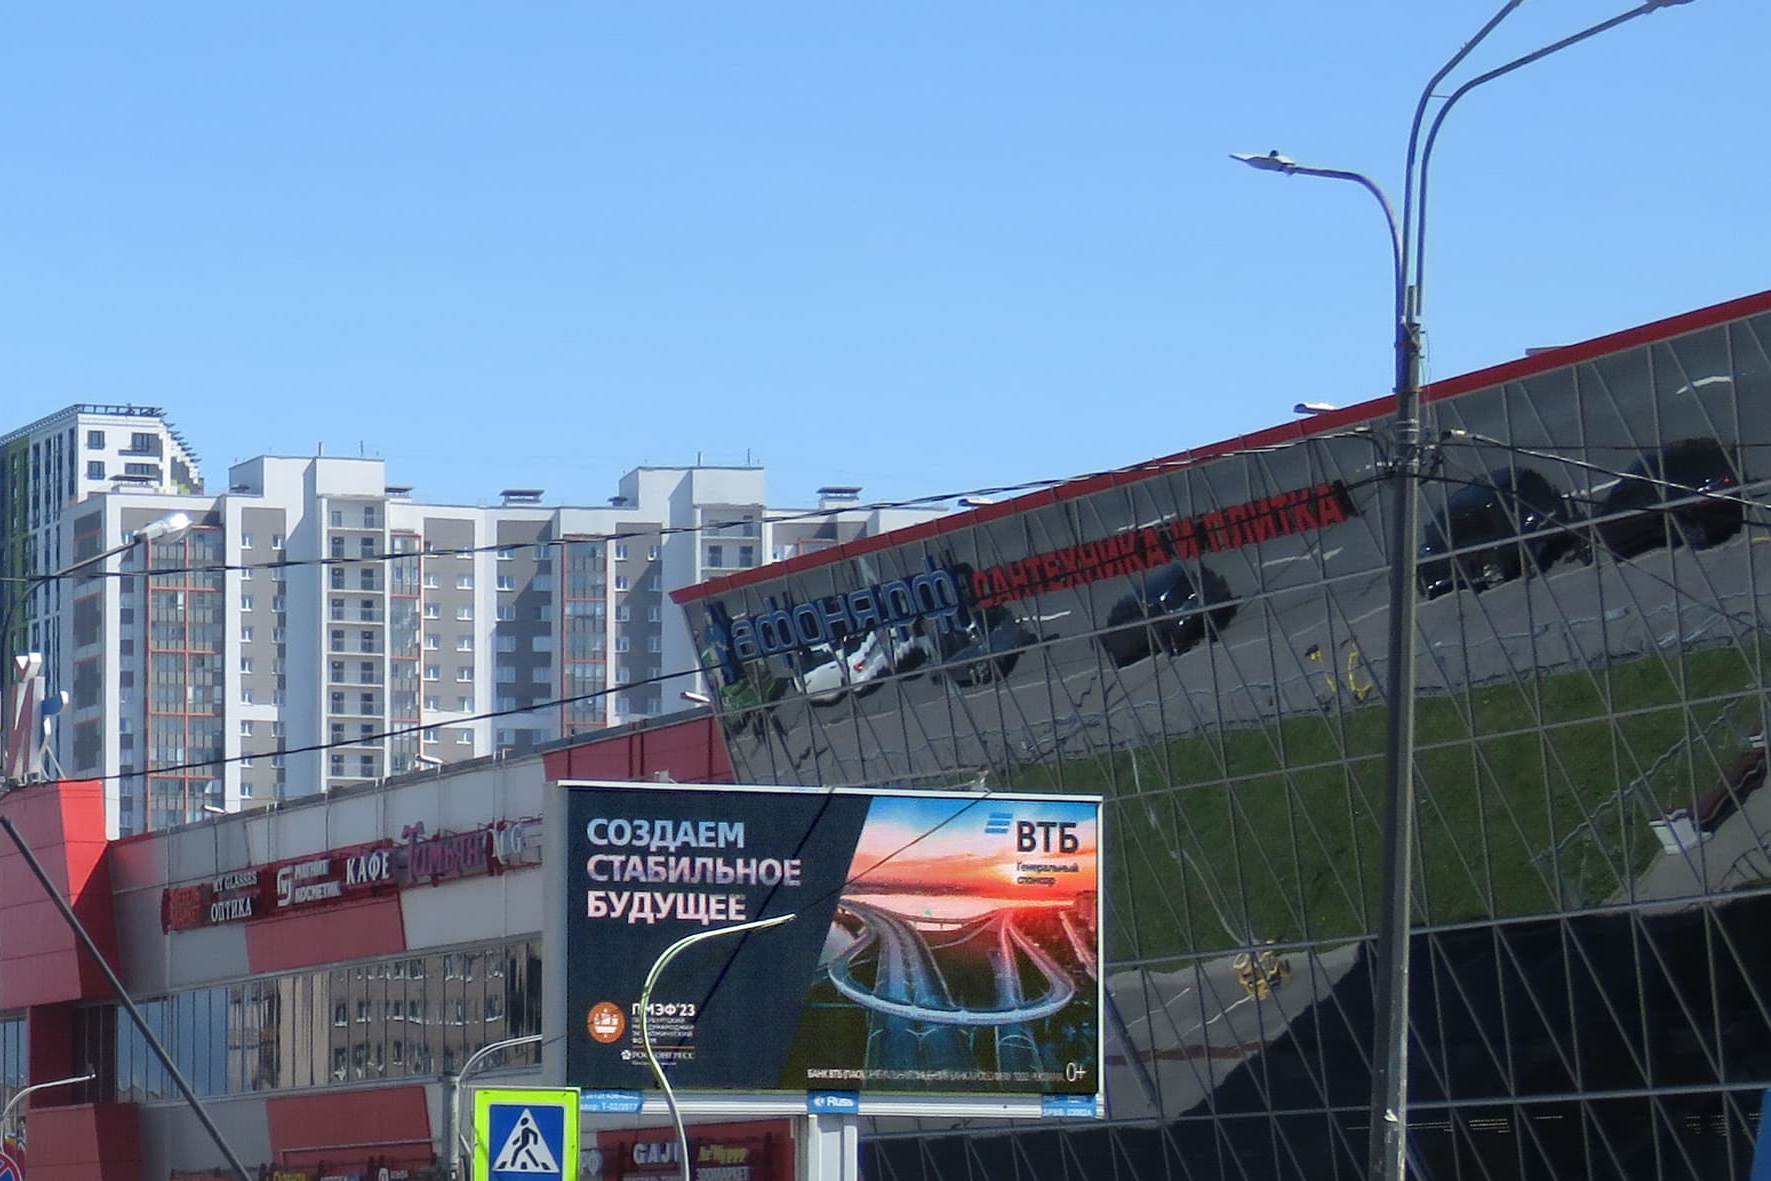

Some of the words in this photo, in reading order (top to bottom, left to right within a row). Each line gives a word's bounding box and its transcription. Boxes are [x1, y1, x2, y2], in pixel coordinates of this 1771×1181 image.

[972, 527, 1171, 608] САНТЕХНИКА
[1171, 518, 1202, 560] И
[1203, 484, 1346, 553] ПЛИТКА
[586, 817, 746, 852] СОЗДАЕМ
[1017, 820, 1079, 854] ВТБ
[346, 851, 391, 885] КАФЕ
[586, 854, 802, 888] СТАБИЛЬНОЕ
[1016, 862, 1079, 874] Генеральный
[211, 897, 253, 923] ОПТИКА
[586, 890, 748, 926] БУДУЩЕЕ
[1065, 1062, 1087, 1083] 0+
